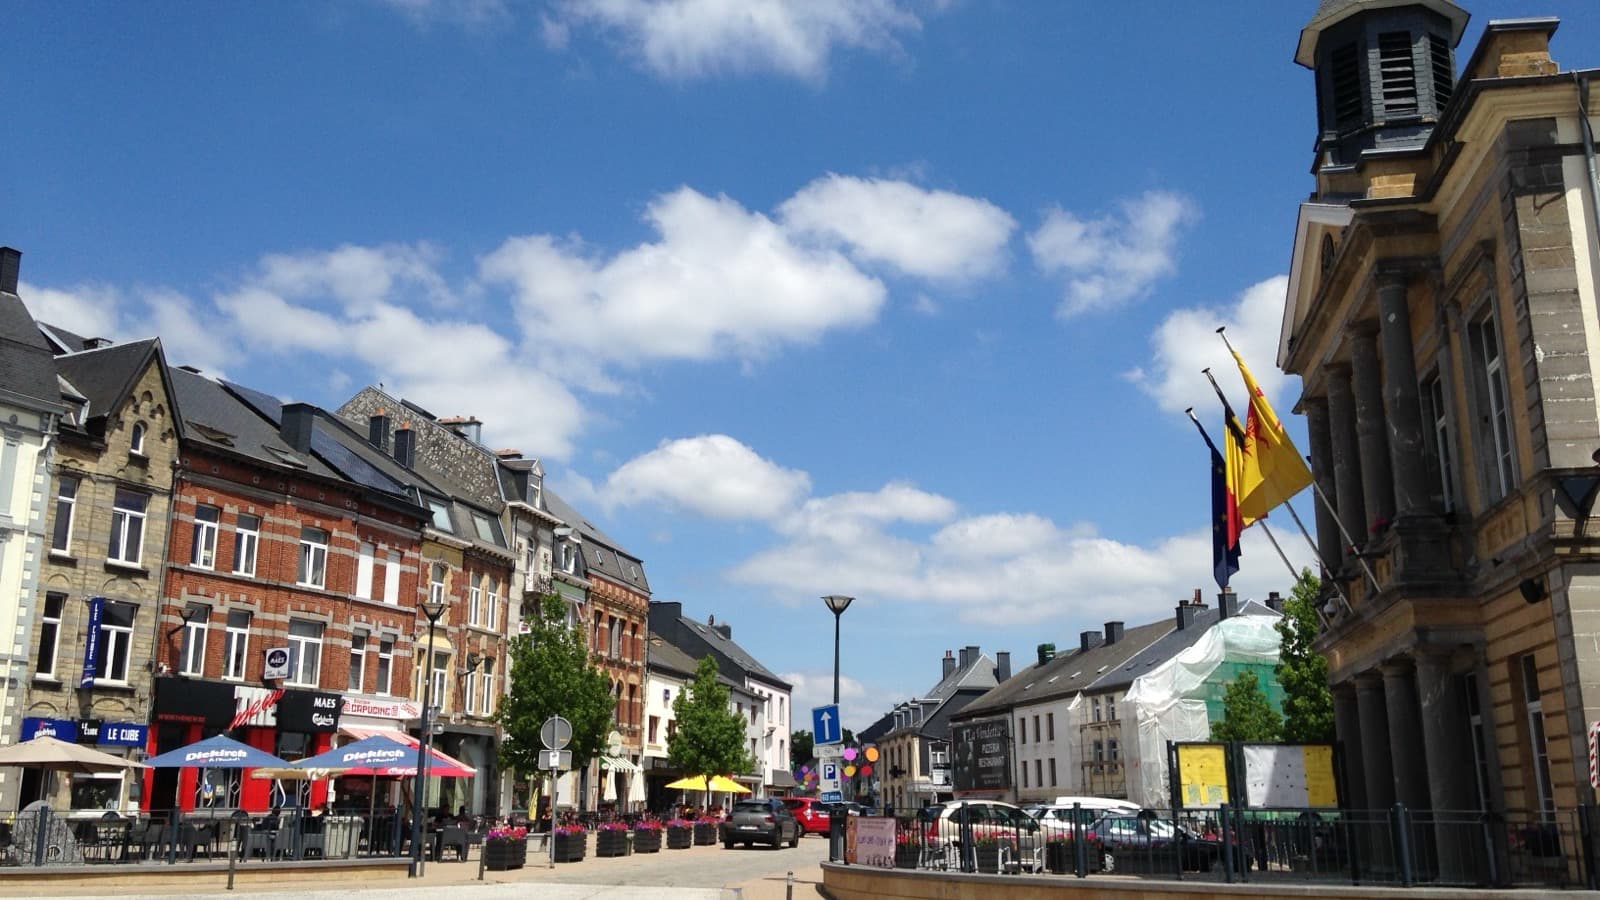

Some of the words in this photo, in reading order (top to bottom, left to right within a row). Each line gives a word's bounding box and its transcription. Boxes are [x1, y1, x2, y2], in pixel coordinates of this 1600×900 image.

[313, 697, 336, 708] MAES
[351, 704, 391, 716] CAPUCINE
[107, 728, 118, 740] LE
[120, 729, 140, 741] CUBE
[185, 749, 247, 761] Diekirch
[343, 749, 405, 762] Diekirch
[825, 765, 834, 779] P
